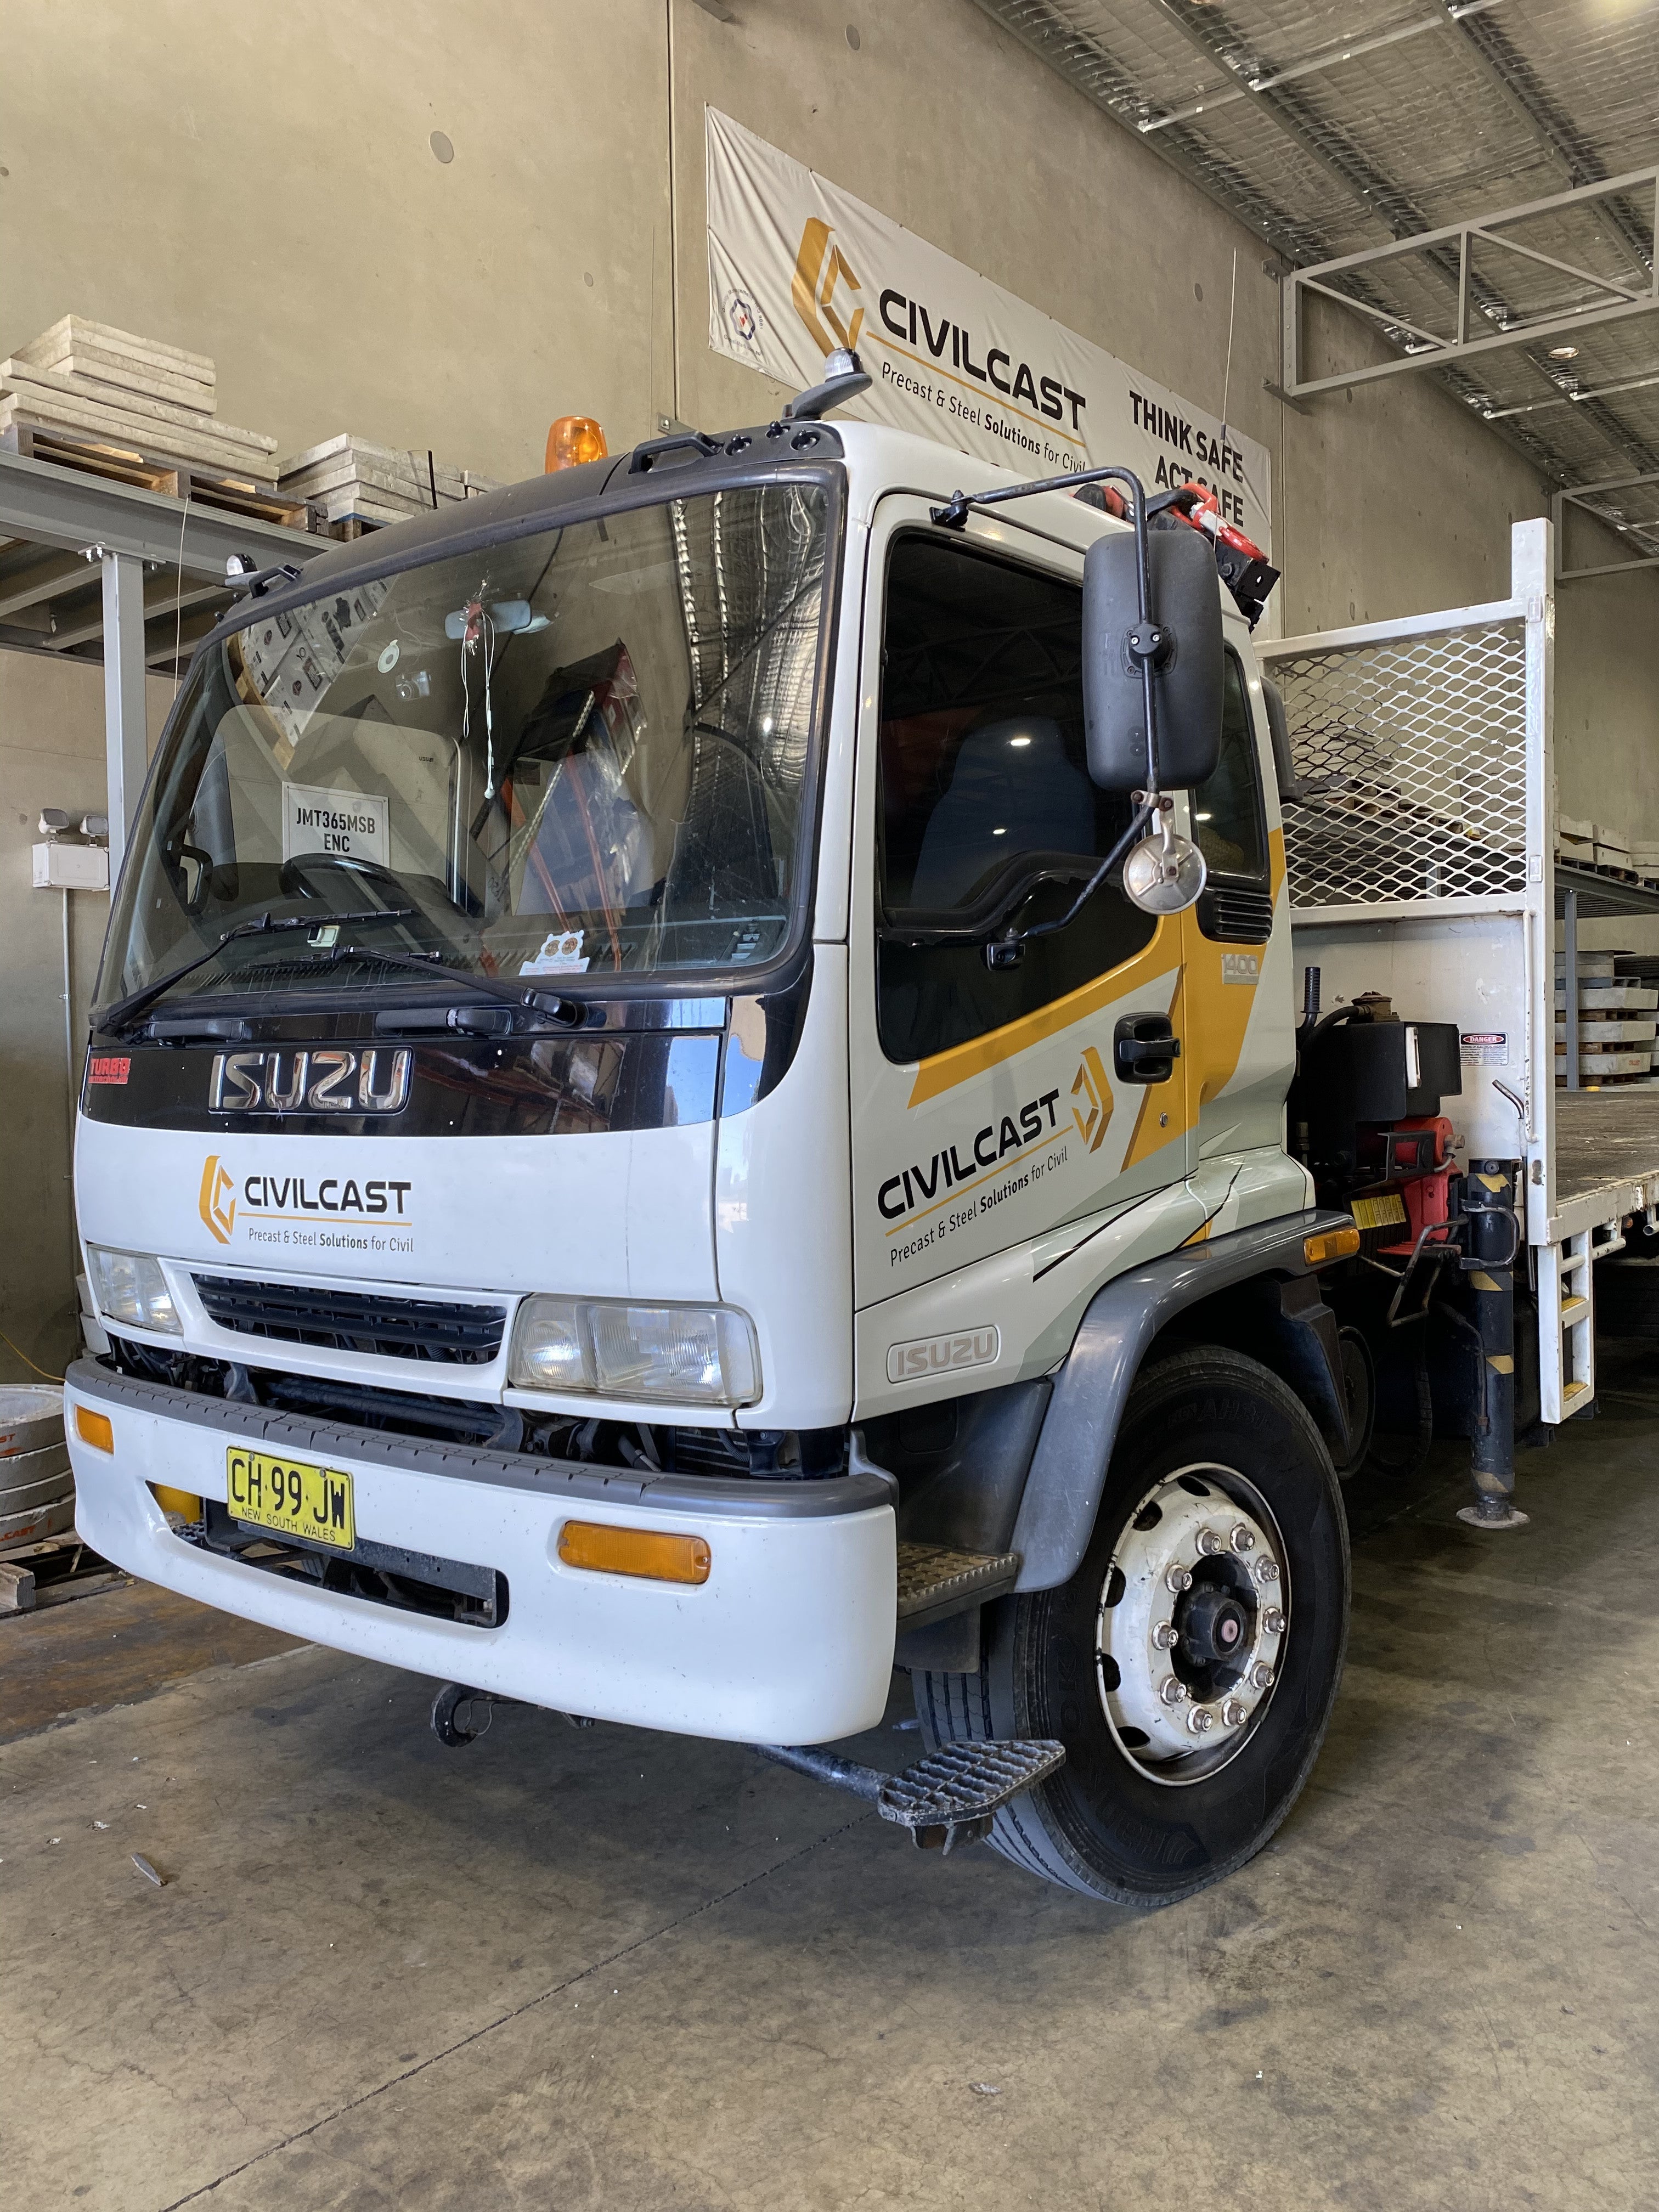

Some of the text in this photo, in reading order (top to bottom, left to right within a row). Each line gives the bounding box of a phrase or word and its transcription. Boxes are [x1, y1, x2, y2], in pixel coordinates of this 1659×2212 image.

[879, 289, 1086, 431] CIVILCAST
[882, 362, 1086, 473] Precast & Steel Solutions for Civil
[1130, 390, 1243, 483] THINK SAFE
[297, 808, 375, 834] JMT365MSB
[324, 833, 350, 852] ENC
[91, 1058, 129, 1075] TURBO
[208, 1051, 409, 1110] ISUZU
[878, 1088, 1059, 1220] CIVILCAST
[245, 1176, 411, 1214] CIVILCAST
[891, 1146, 1068, 1266] Precast & Steel Solutions for Civil
[249, 1228, 414, 1252] Precast & Steel Solutions for Civil
[897, 1333, 994, 1376] ISUZU
[232, 1458, 345, 1529] CH 99 JW
[242, 1506, 336, 1542] NEW SOUTH WALES
